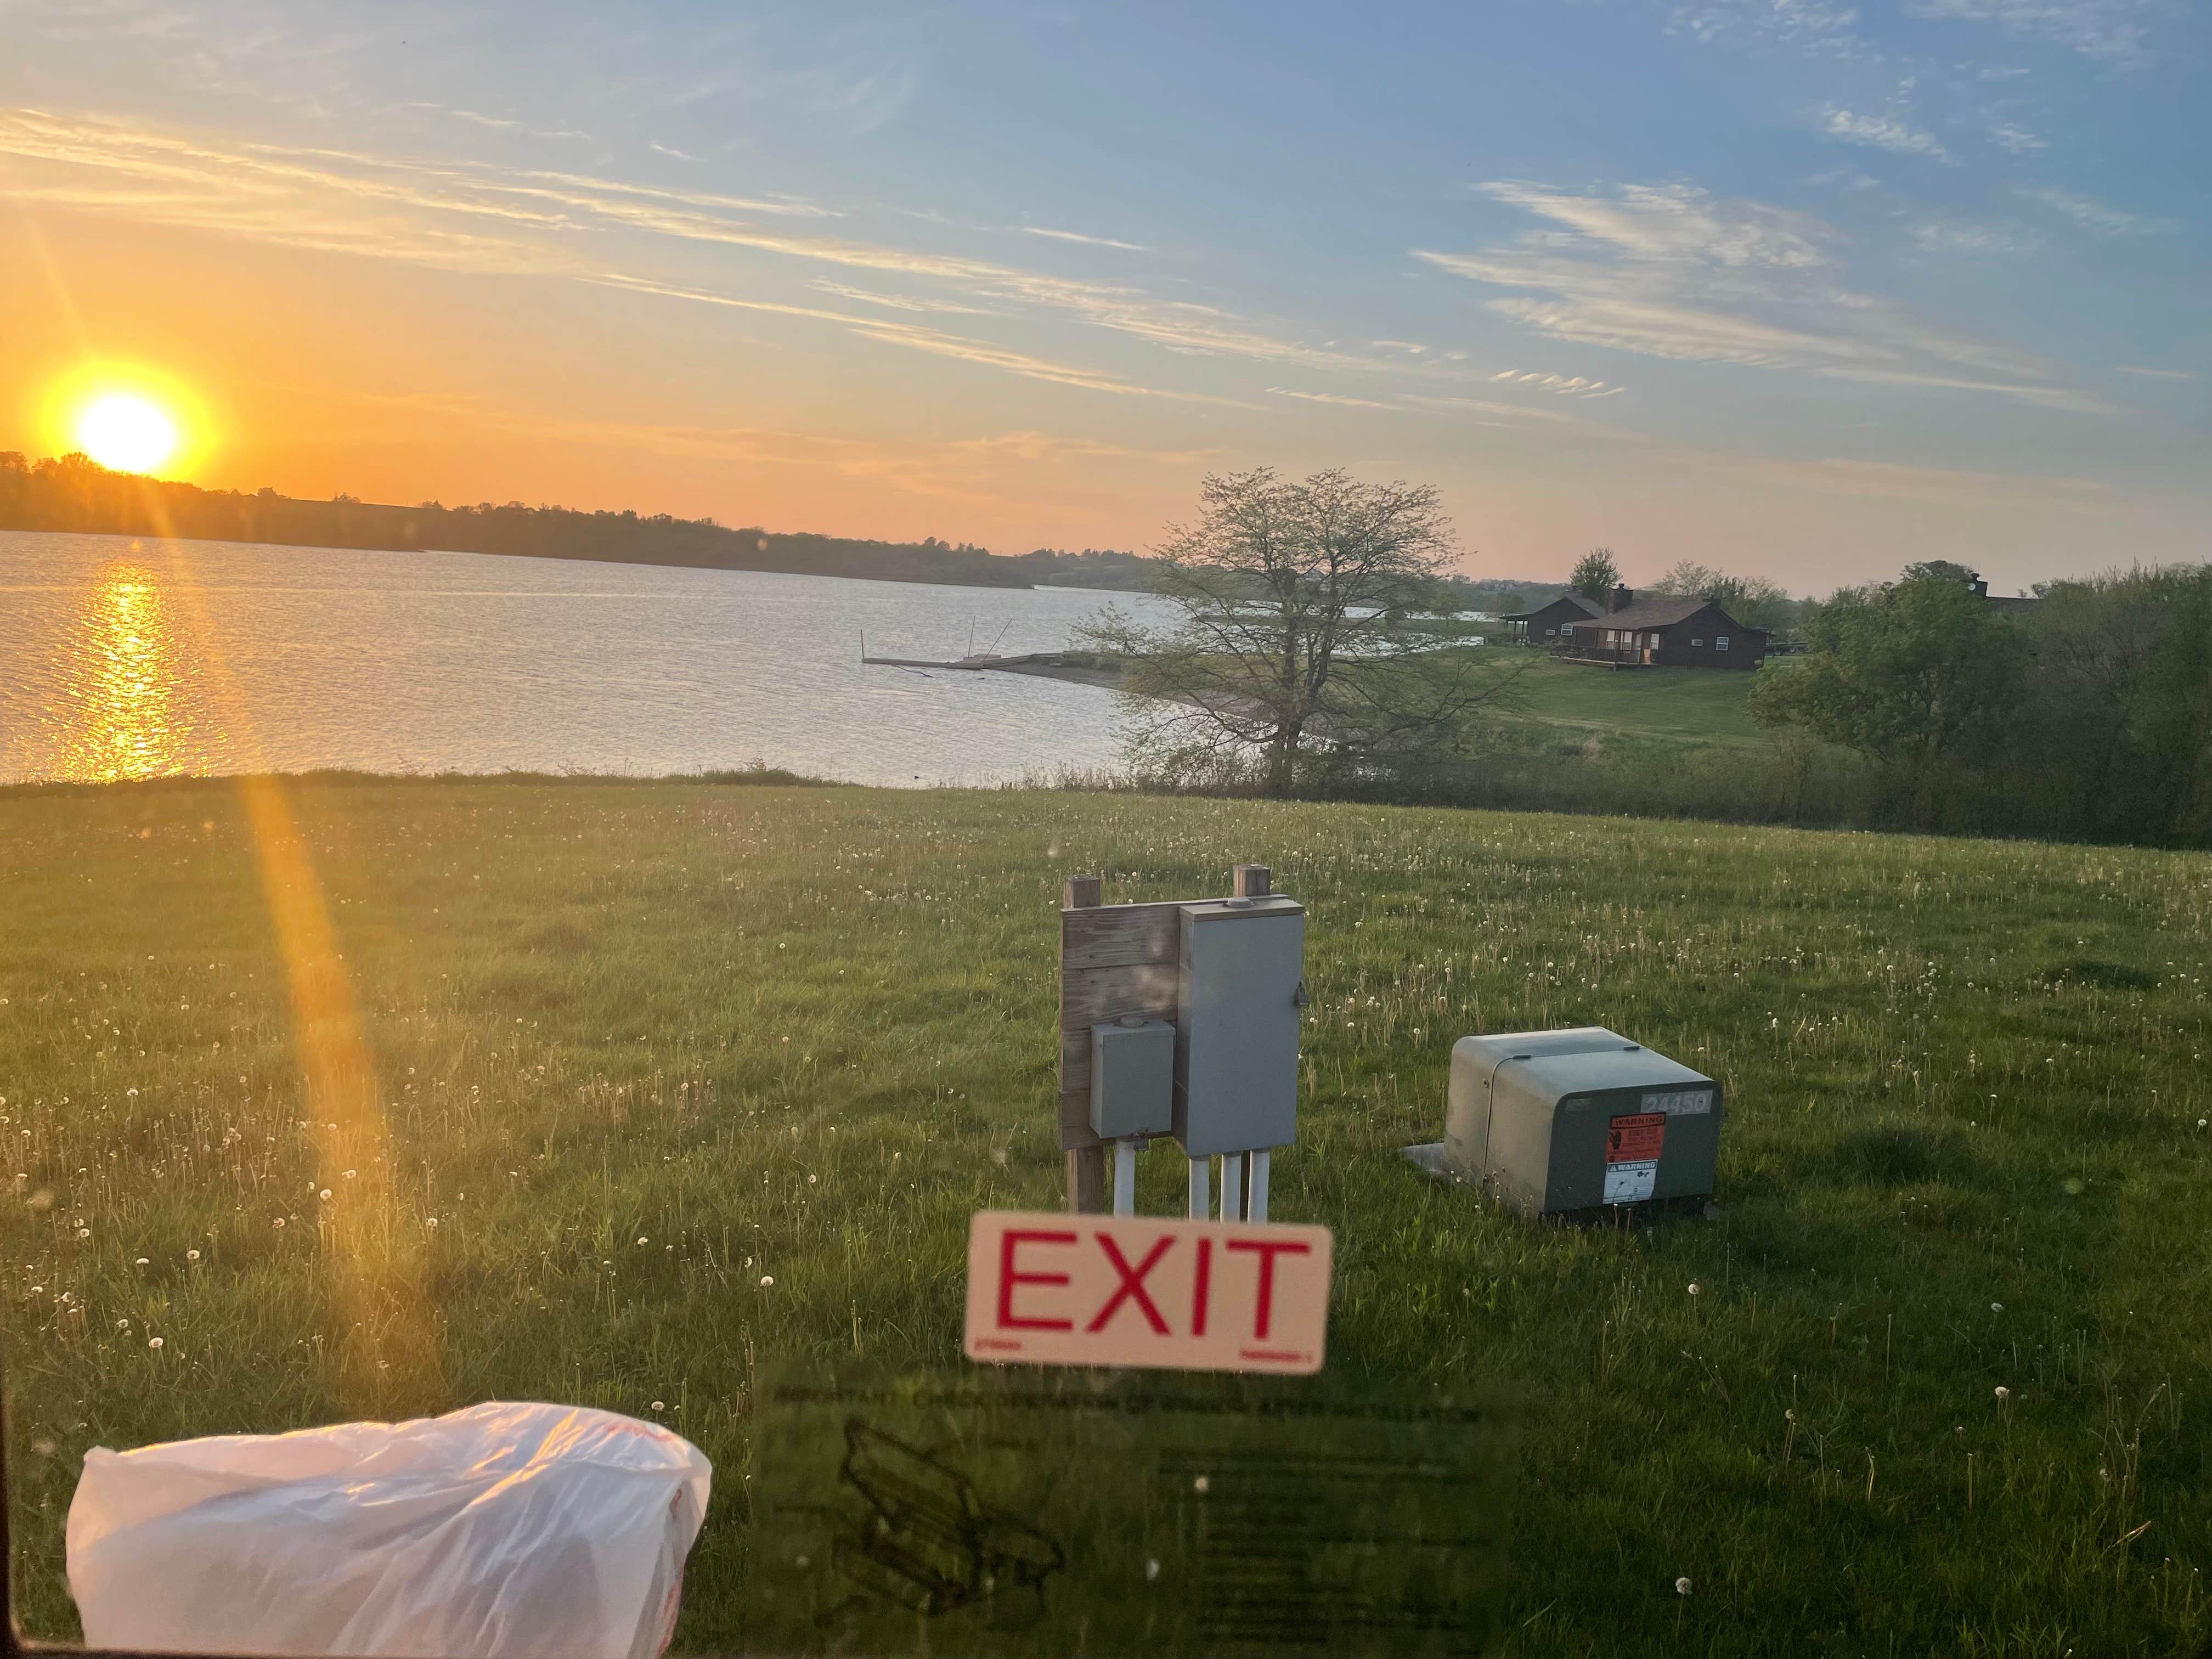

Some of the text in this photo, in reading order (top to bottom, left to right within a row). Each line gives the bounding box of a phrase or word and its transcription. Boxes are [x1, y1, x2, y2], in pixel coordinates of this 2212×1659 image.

[1615, 1115, 1663, 1126] WARNING
[1617, 1161, 1655, 1171] WARNING
[996, 1227, 1312, 1341] EXIT
